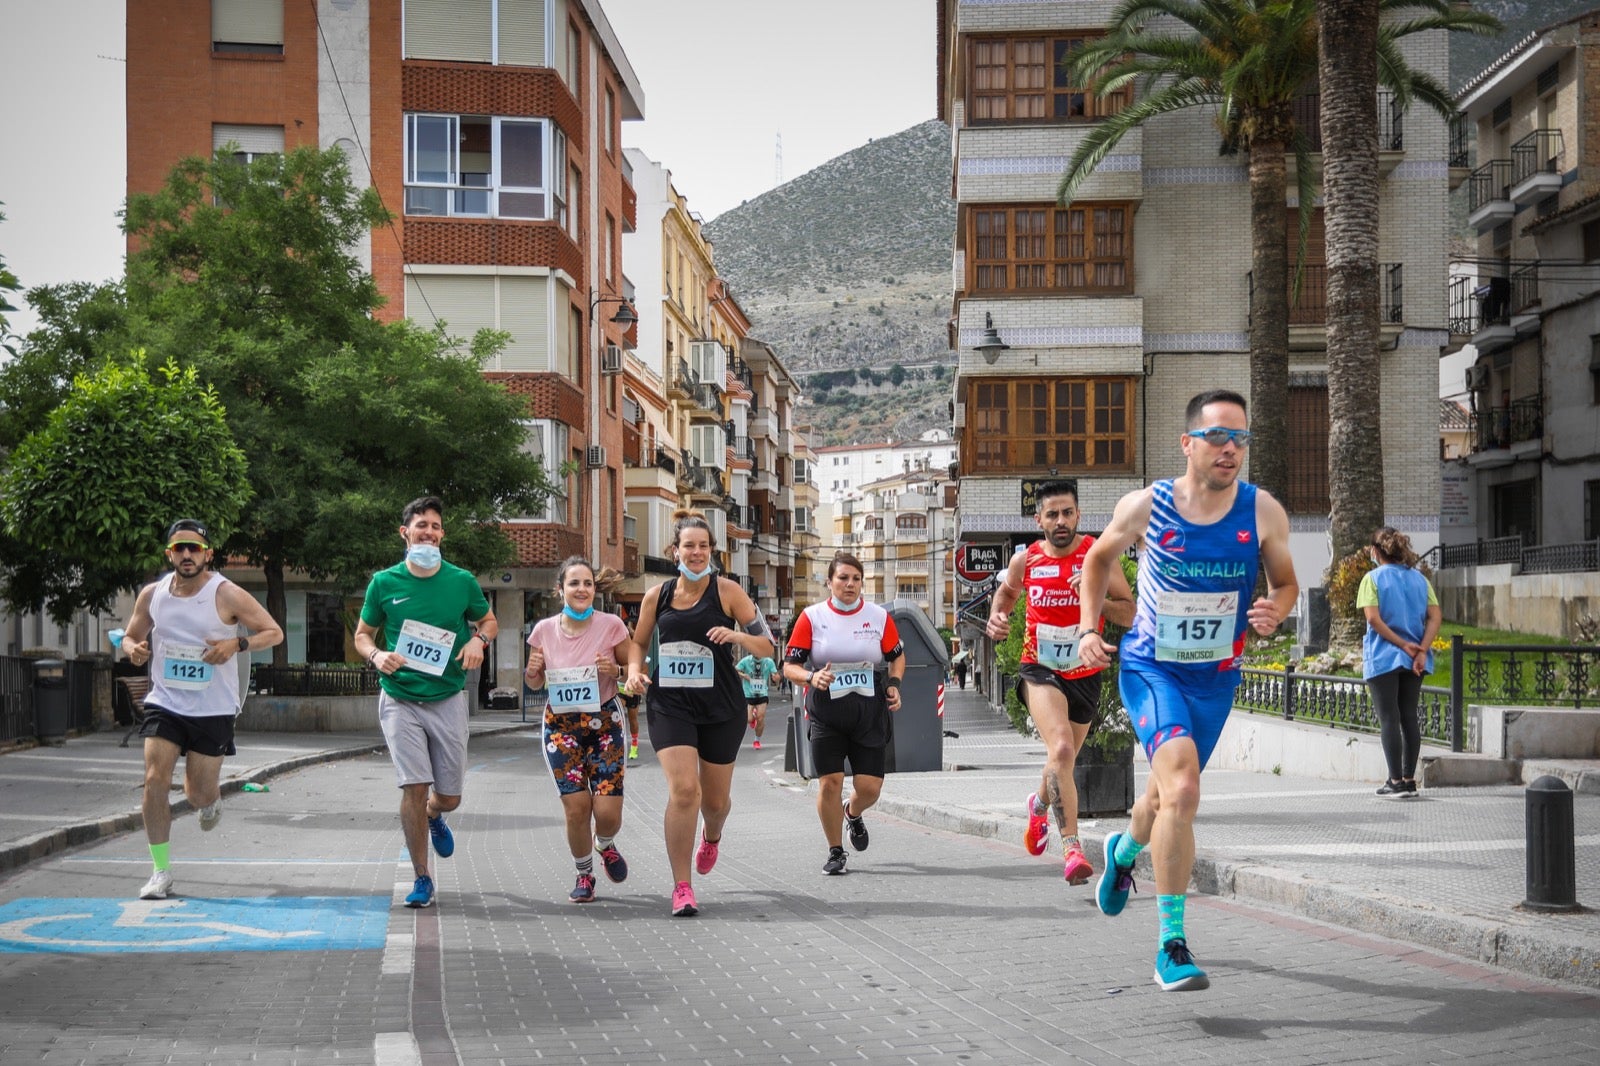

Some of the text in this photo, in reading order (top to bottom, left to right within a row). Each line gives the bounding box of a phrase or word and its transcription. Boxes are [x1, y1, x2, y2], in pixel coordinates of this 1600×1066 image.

[1159, 562, 1246, 578] SONRIALIA
[1029, 585, 1081, 607] Polisalu
[1177, 619, 1222, 641] 157
[407, 641, 442, 662] 1073
[1053, 643, 1073, 657] 77
[1176, 650, 1214, 660] FRANCISCO
[172, 664, 205, 678] 1121
[669, 661, 704, 675] 1071
[836, 673, 867, 686] 1070
[557, 687, 592, 702] 1072
